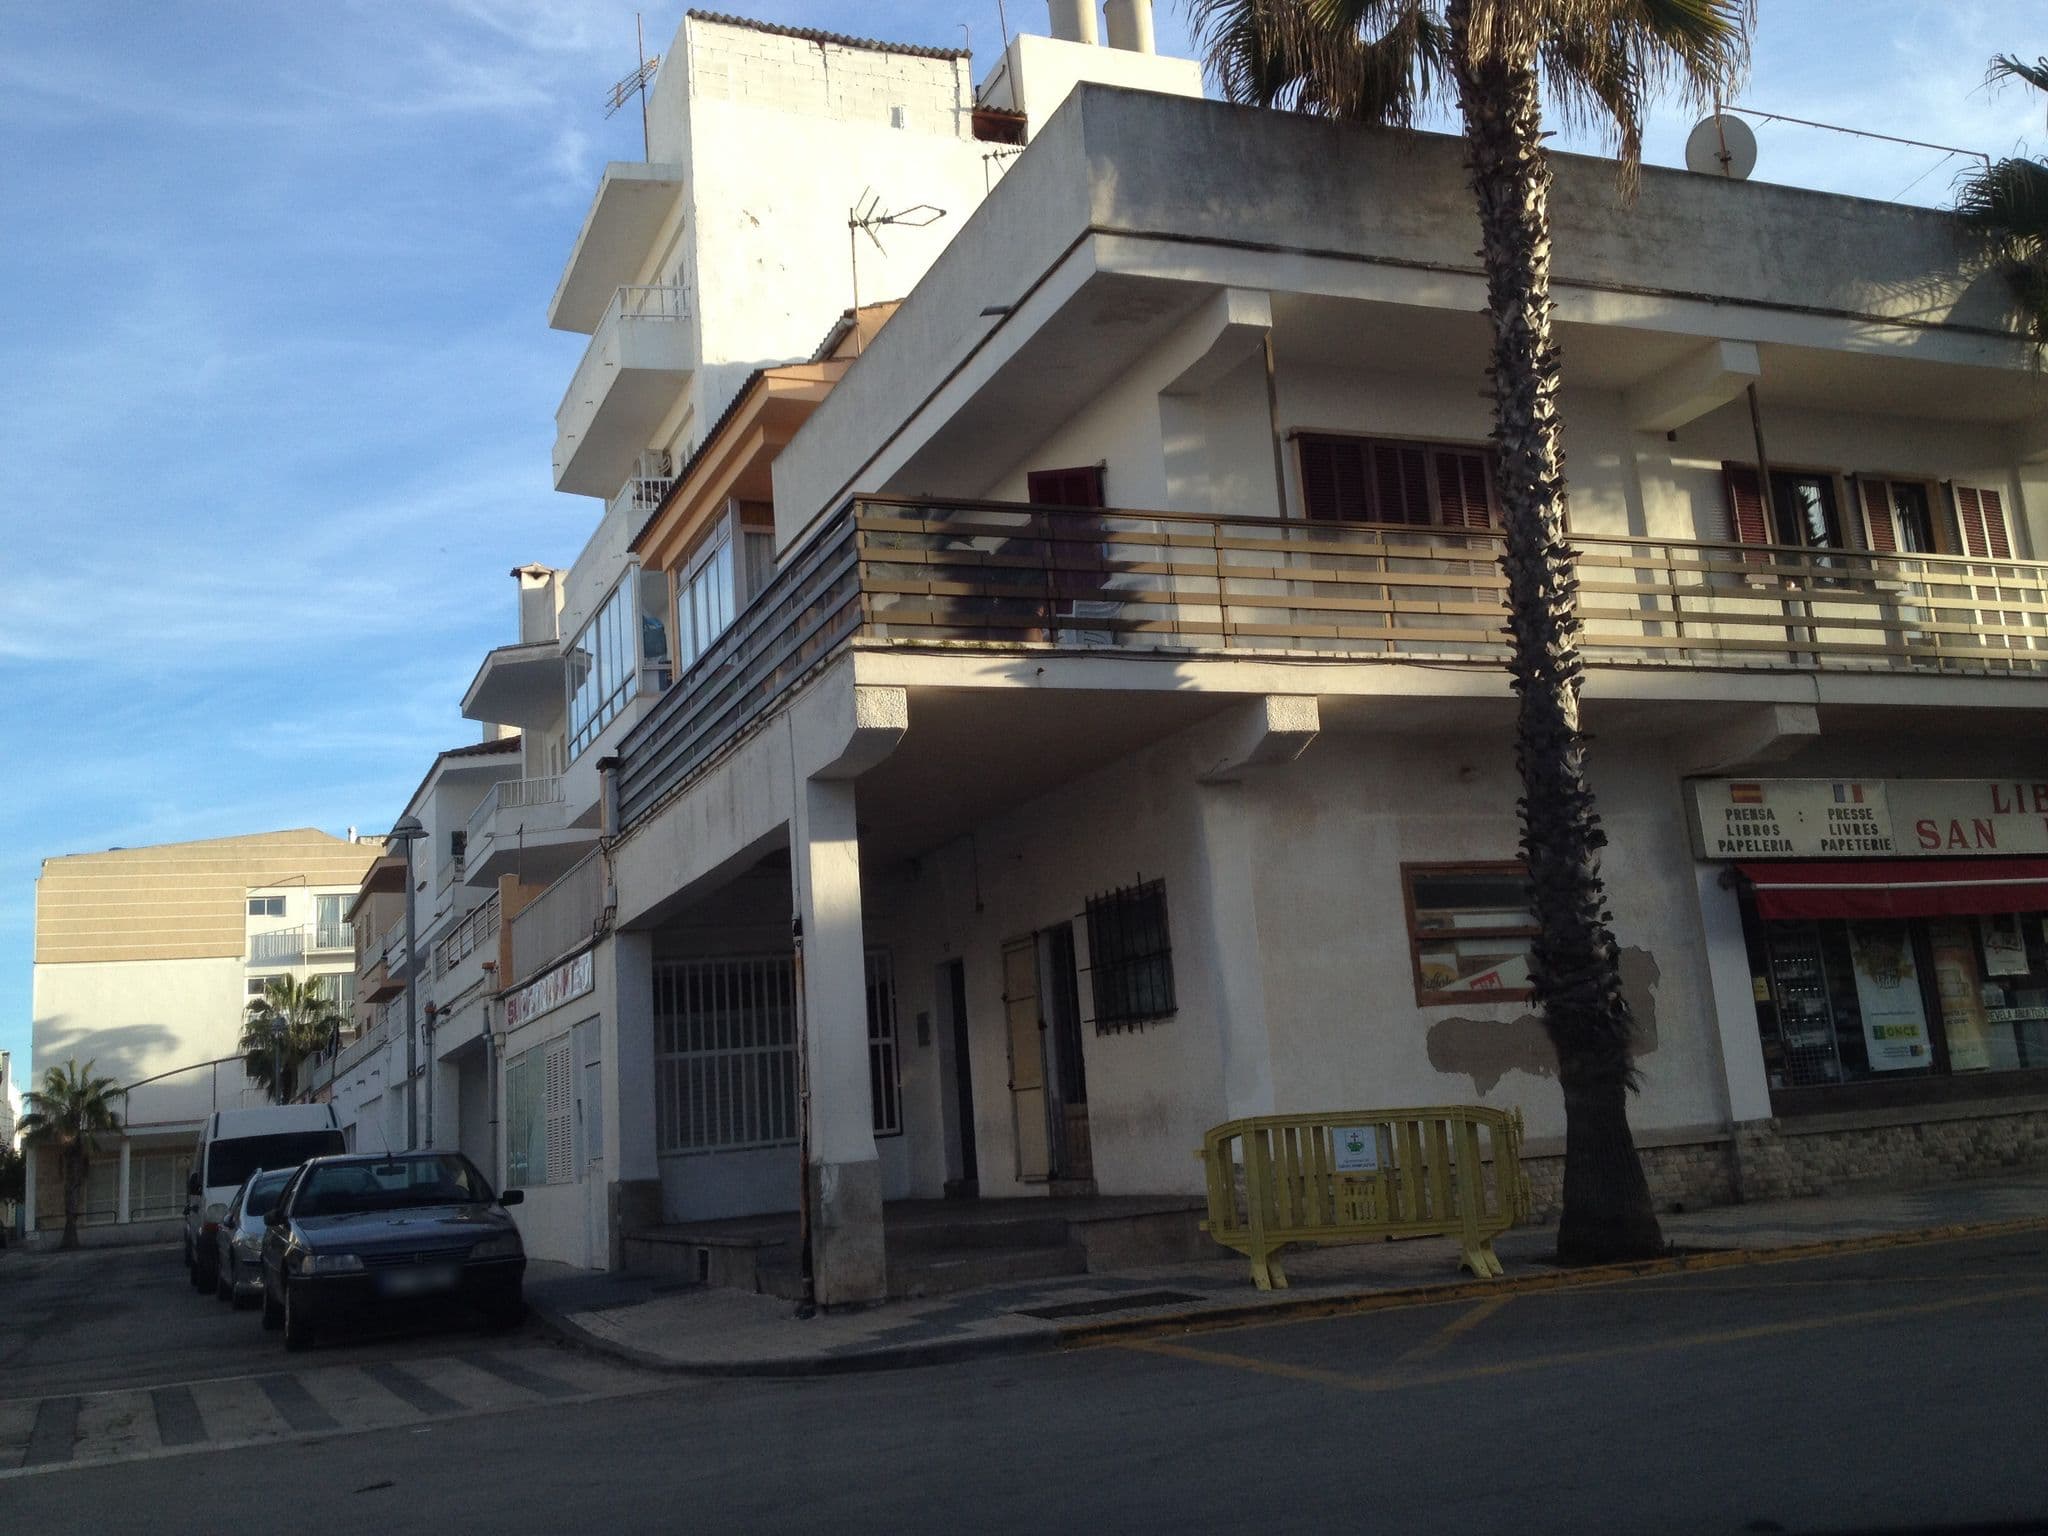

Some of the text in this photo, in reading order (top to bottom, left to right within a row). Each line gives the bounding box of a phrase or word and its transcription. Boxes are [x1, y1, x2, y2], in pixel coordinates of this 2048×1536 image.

[1827, 808, 1874, 820] PRESSE
[1726, 824, 1780, 836] LIBROS
[1828, 823, 1879, 835] LIVRES
[1916, 819, 1997, 849] SAN
[1718, 839, 1793, 852] PAPELERIA
[1821, 838, 1892, 851] PAPETERIE
[1886, 1024, 1918, 1037] ONCE
